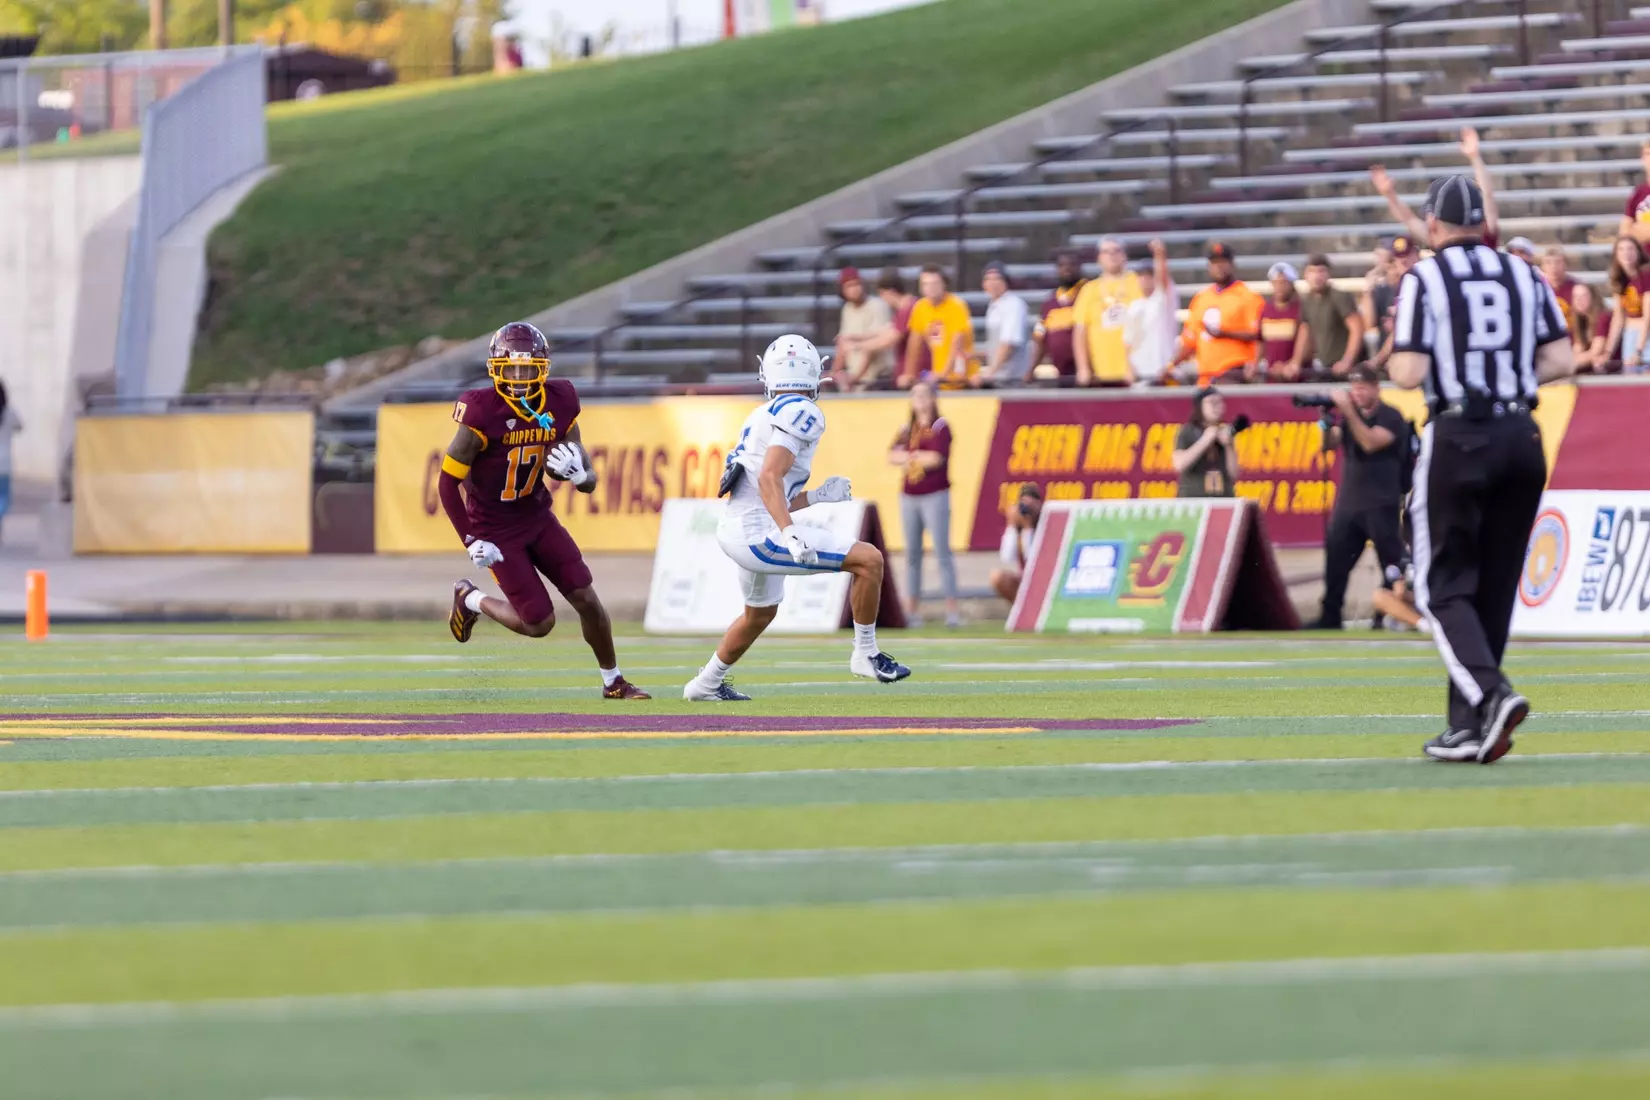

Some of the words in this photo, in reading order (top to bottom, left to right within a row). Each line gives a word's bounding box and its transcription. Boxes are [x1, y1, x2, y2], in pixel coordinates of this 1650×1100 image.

[1460, 280, 1512, 350] B
[453, 401, 468, 423] 17
[502, 427, 557, 445] CHIPPEWAS
[791, 409, 817, 434] 15
[500, 444, 546, 502] 17
[1007, 423, 1085, 476] SEVEN
[1575, 542, 1609, 612] IBEW
[1601, 506, 1650, 612] 87
